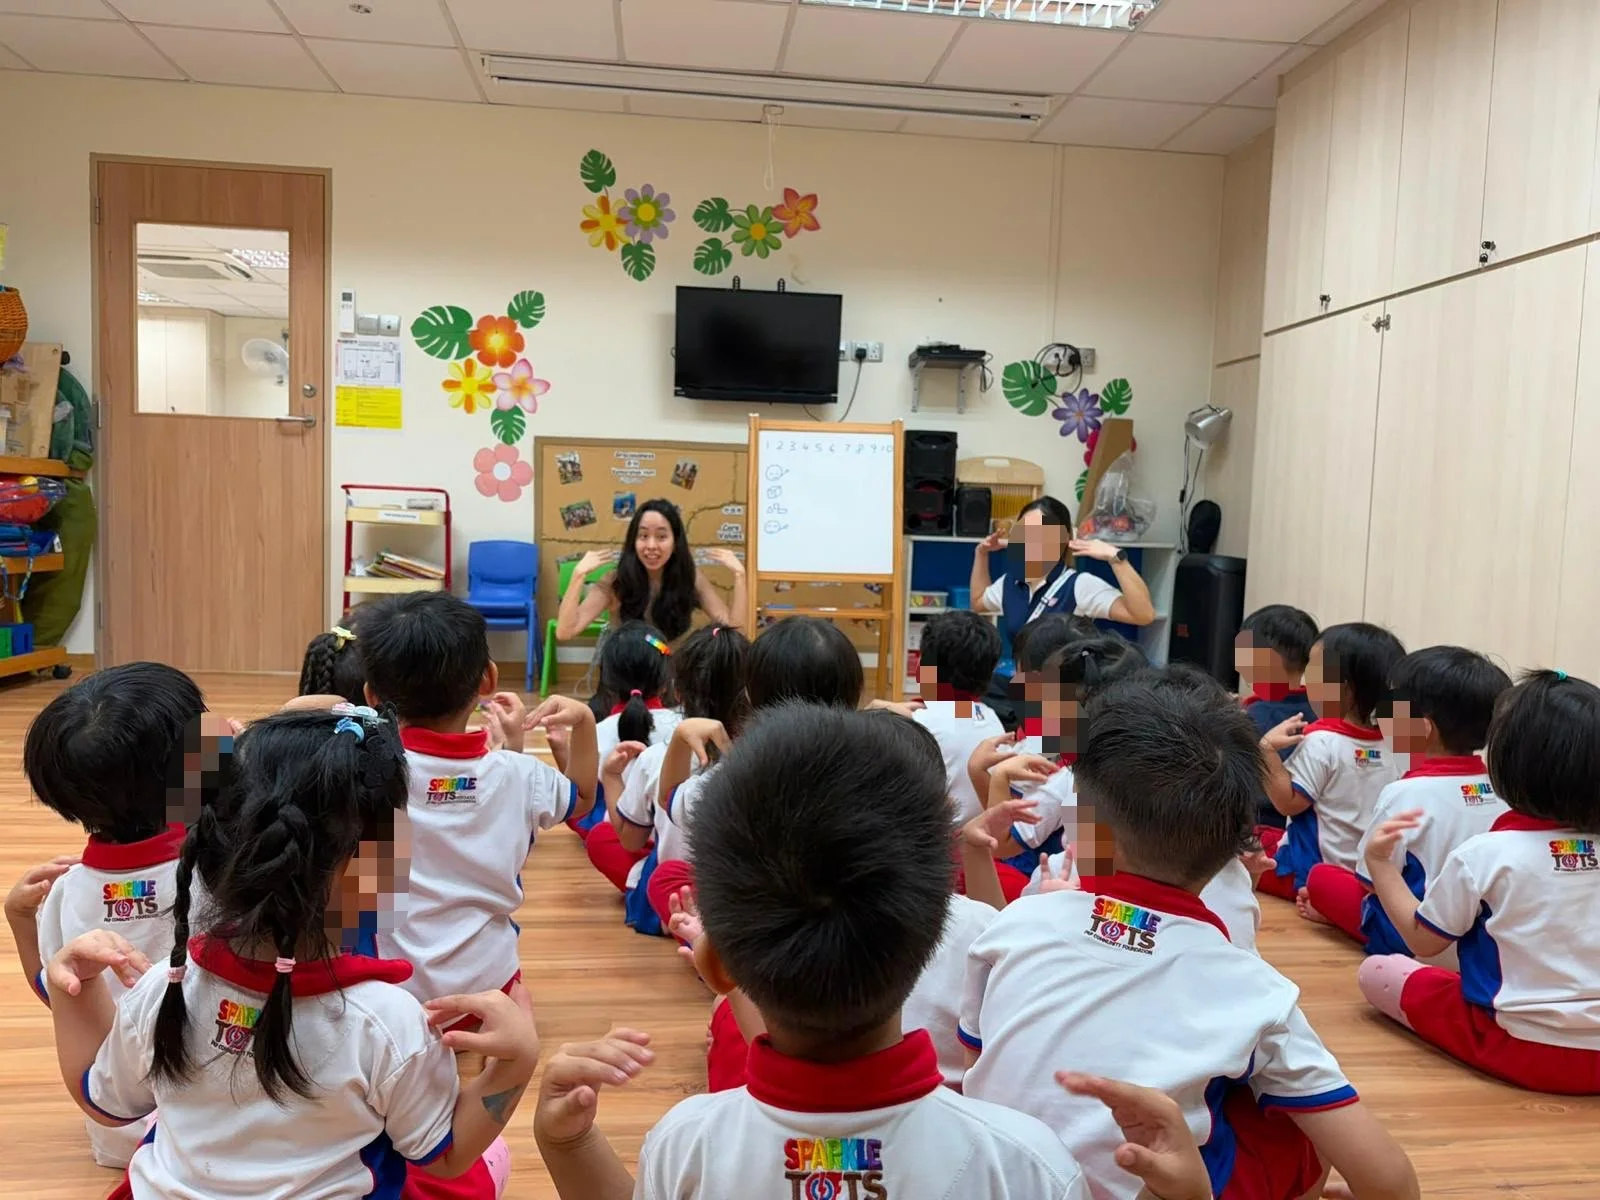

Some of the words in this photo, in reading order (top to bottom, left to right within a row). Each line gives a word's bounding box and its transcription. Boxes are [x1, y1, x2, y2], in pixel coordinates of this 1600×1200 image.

[776, 440, 784, 450] 2
[789, 440, 797, 451] 3
[803, 441, 809, 450] 4
[815, 442, 823, 452] 5
[829, 442, 836, 453] 6
[845, 443, 851, 452] 7
[855, 443, 865, 454] 8
[870, 441, 877, 454] 9
[429, 777, 477, 791] SPARKLE
[427, 791, 457, 801] TOTS
[1549, 839, 1595, 856] SPARKLE
[1551, 854, 1599, 868] TOTS
[103, 880, 157, 899] SPARKLE
[103, 897, 159, 918] TOTS
[1092, 898, 1162, 934] SPARKLE
[1091, 914, 1156, 950] TOTS
[784, 1137, 883, 1171] SPARKLE
[784, 1171, 888, 1200] TOTS
